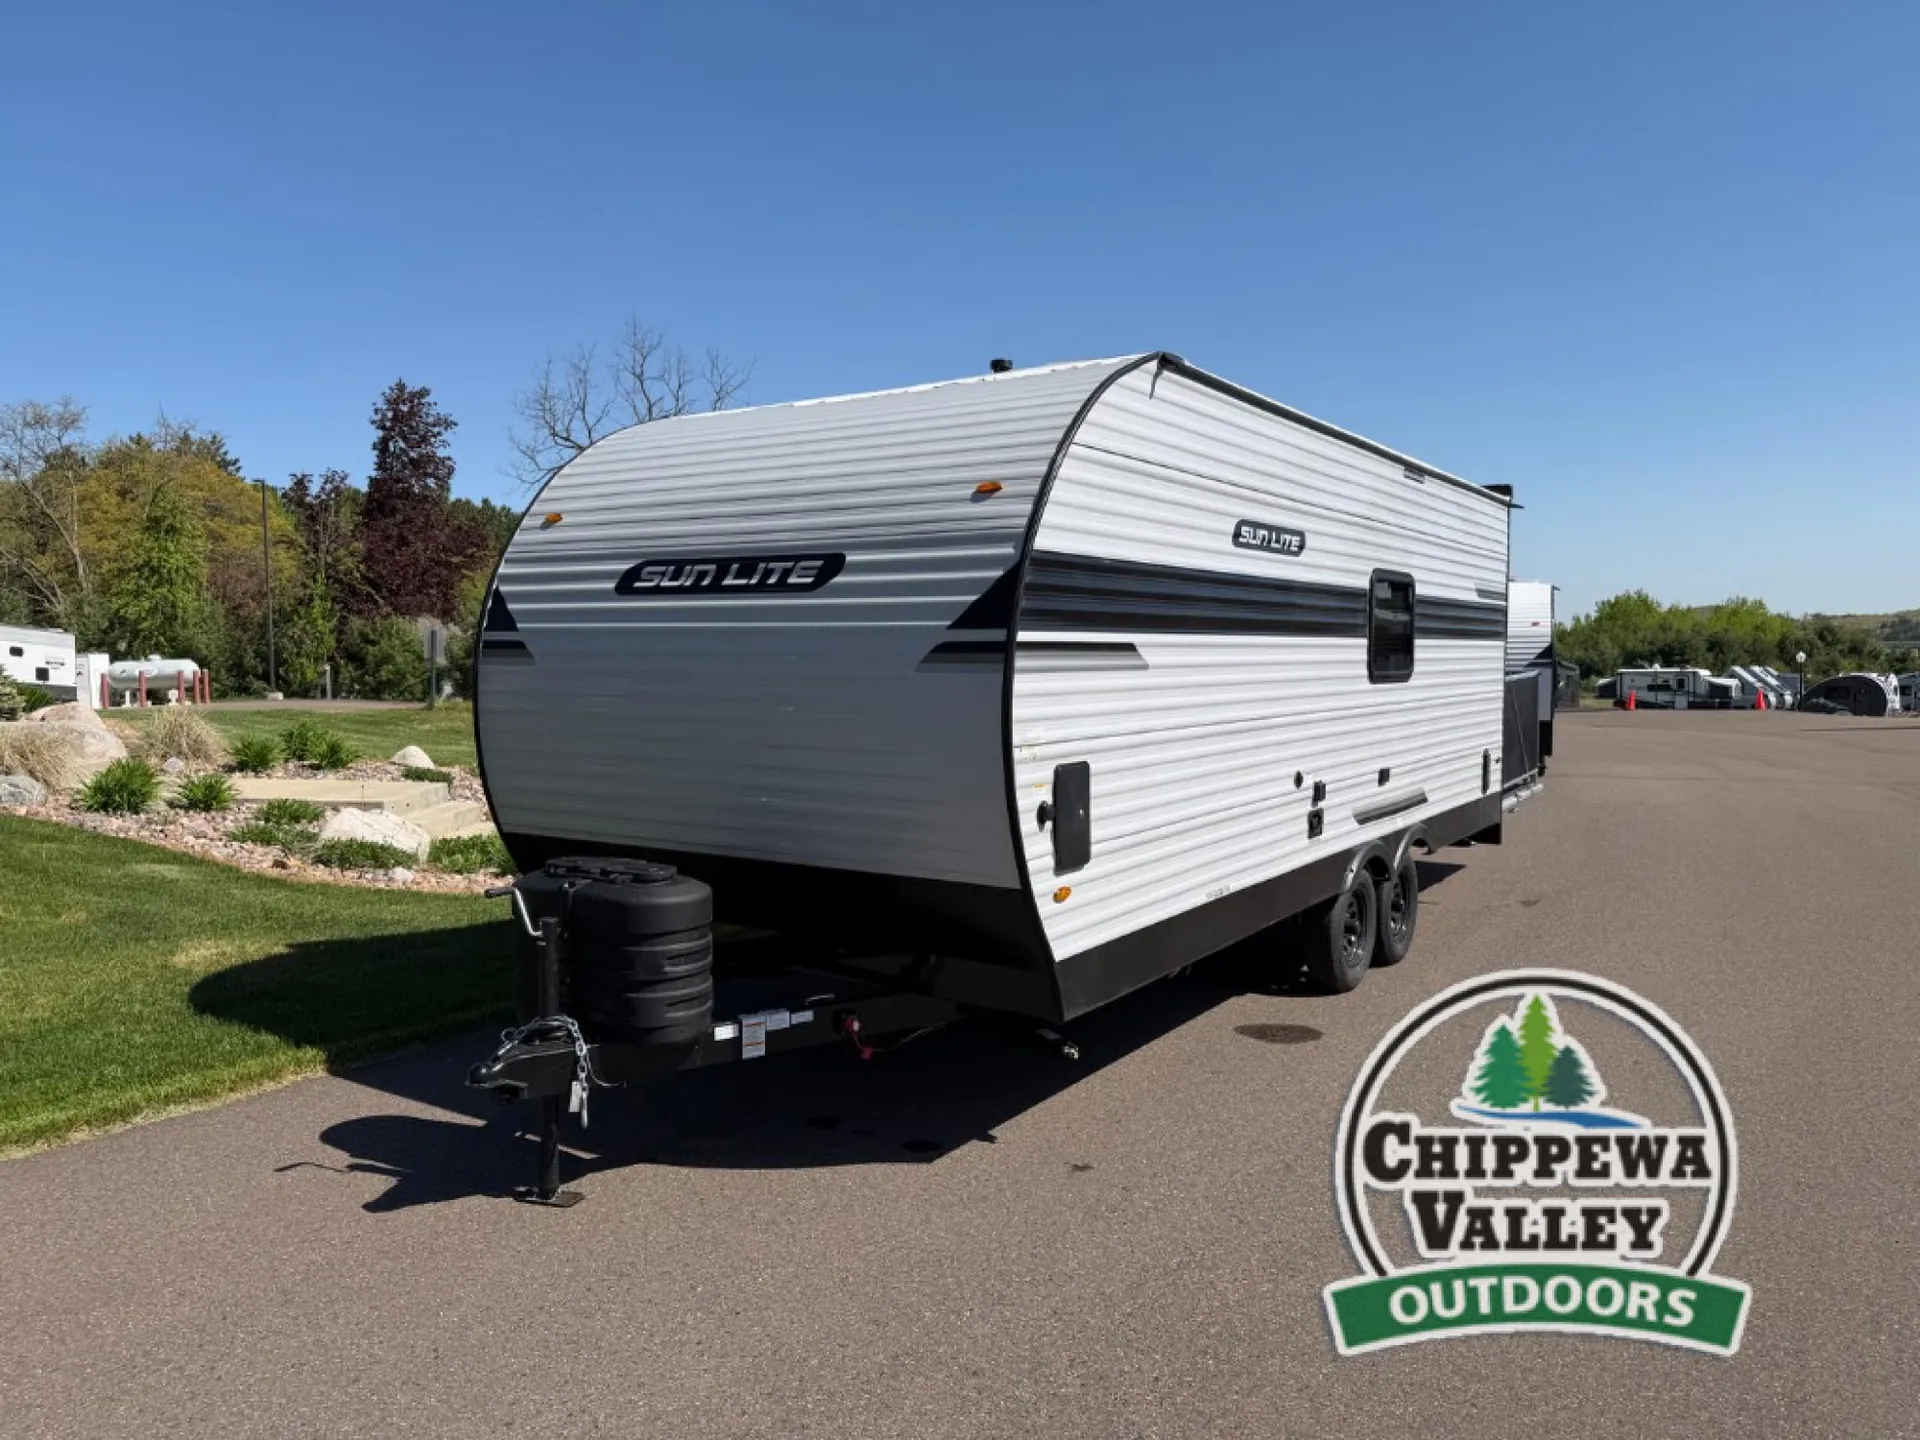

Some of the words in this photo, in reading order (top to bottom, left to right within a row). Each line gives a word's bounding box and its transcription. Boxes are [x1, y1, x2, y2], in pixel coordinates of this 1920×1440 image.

[1239, 526, 1268, 546] SUN
[1270, 531, 1300, 551] LITE
[633, 563, 717, 587] SUN
[721, 560, 824, 586] LITE
